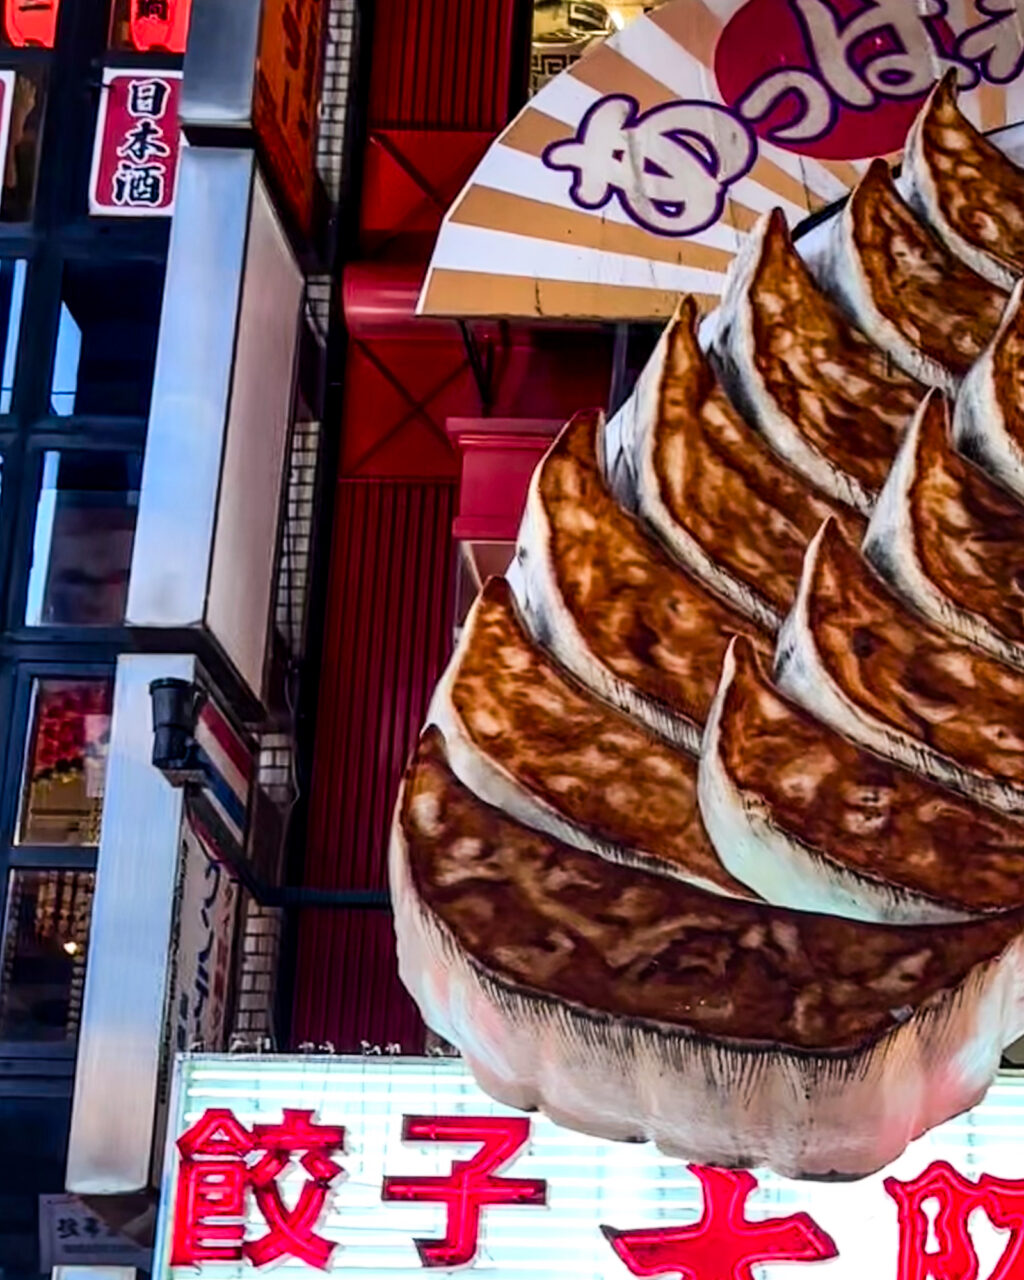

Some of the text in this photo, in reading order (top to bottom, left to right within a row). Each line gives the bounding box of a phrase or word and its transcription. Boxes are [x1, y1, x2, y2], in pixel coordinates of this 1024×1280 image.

[112, 78, 170, 205] 日本酒
[176, 1108, 548, 1270] 餃子
